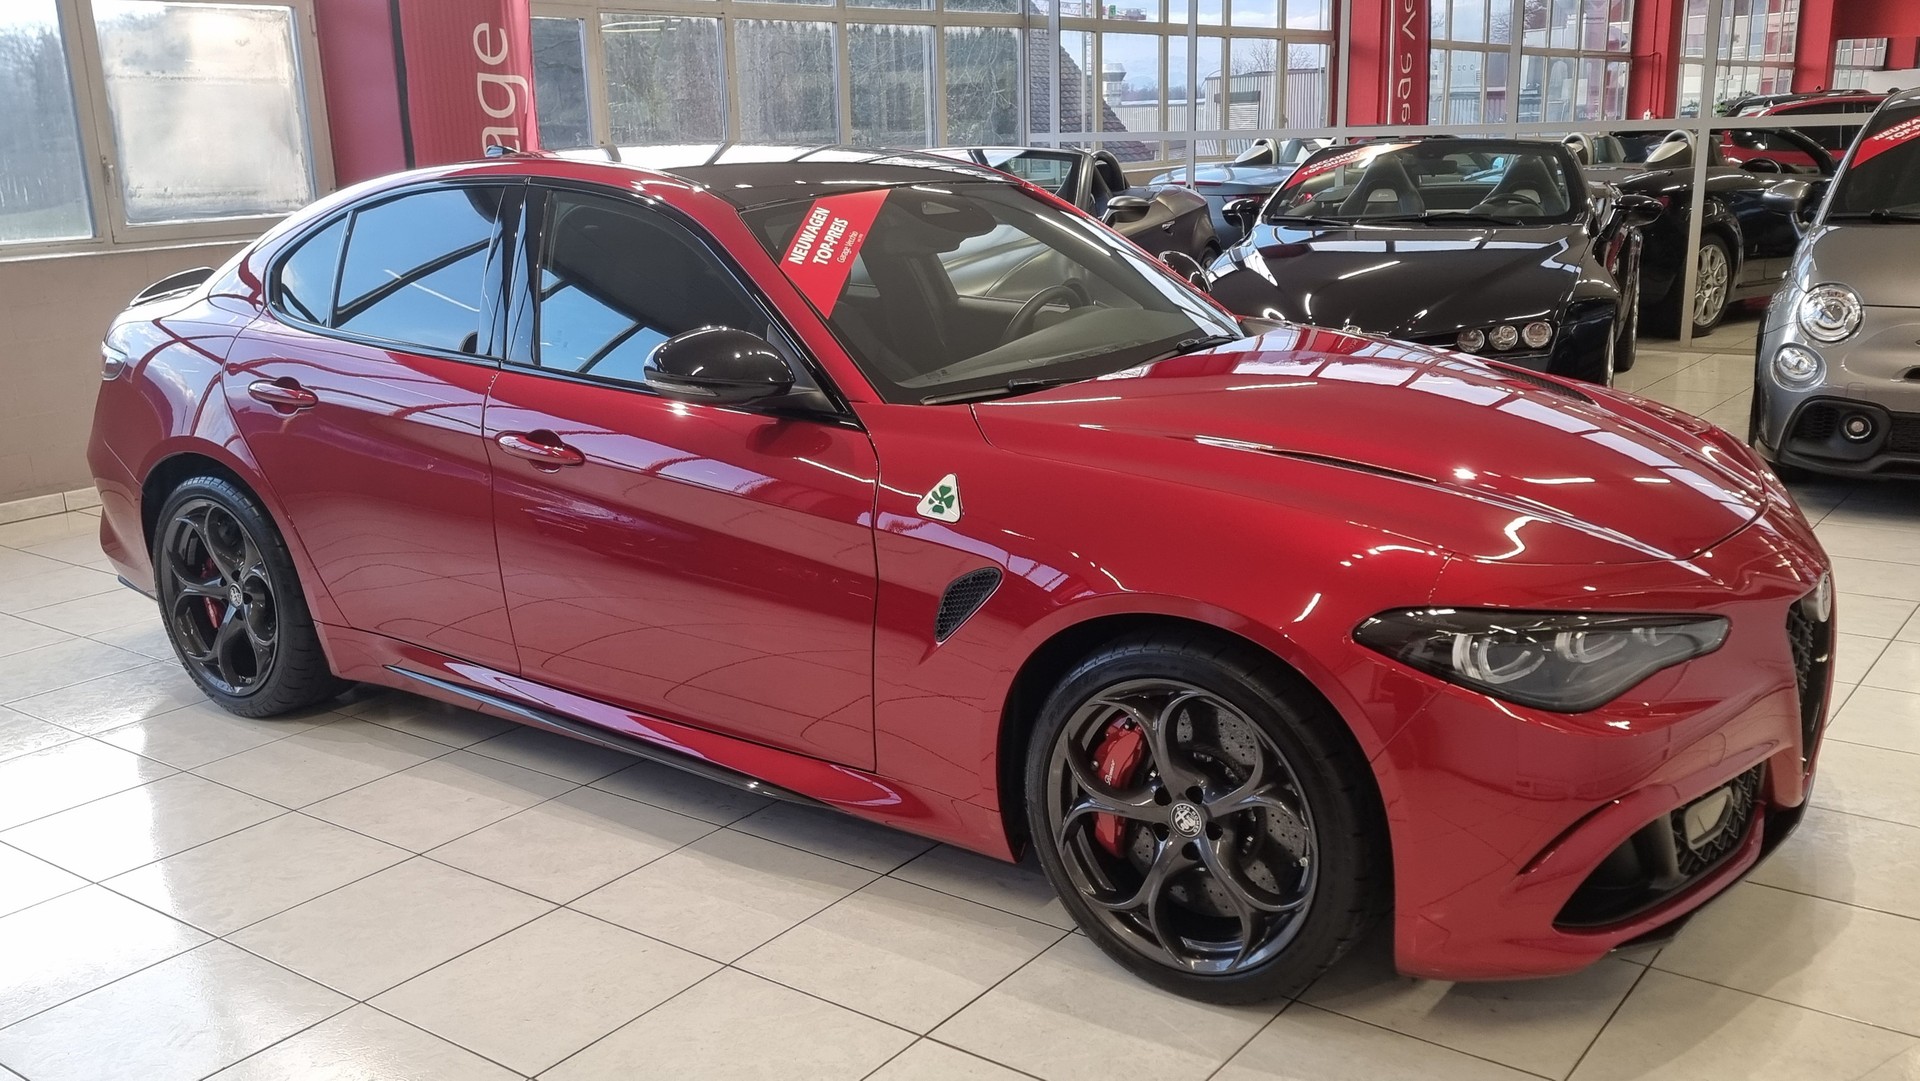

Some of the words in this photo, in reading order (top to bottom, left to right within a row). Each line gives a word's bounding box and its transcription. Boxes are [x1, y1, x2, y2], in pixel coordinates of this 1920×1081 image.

[1309, 150, 1359, 169] OCCASION
[788, 206, 831, 265] NEUWAGEN
[812, 217, 849, 265] TOP-PREIS
[836, 246, 852, 263] Garage
[1191, 811, 1201, 833] ROMEO
